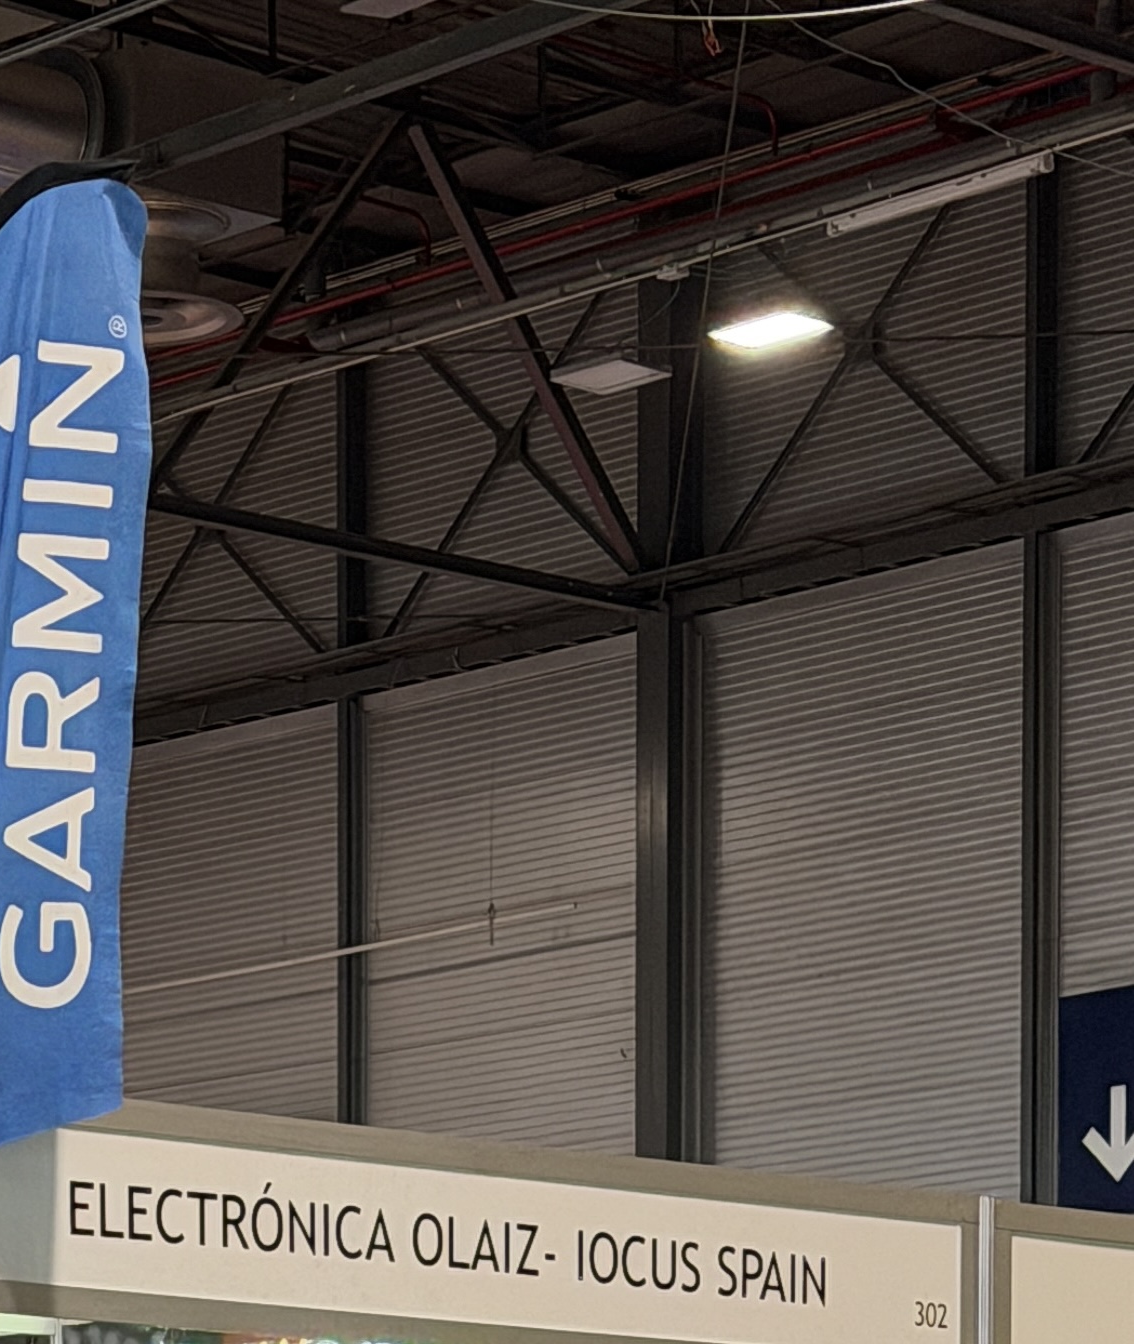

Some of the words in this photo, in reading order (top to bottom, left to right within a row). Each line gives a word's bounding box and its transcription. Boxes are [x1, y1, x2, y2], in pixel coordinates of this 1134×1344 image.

[69, 1181, 395, 1262] ELECTRÓNICA
[412, 1213, 556, 1277] OLAIZ-
[578, 1230, 702, 1292] IOCUS
[718, 1246, 826, 1308] SPAIN
[914, 1301, 948, 1329] 302
